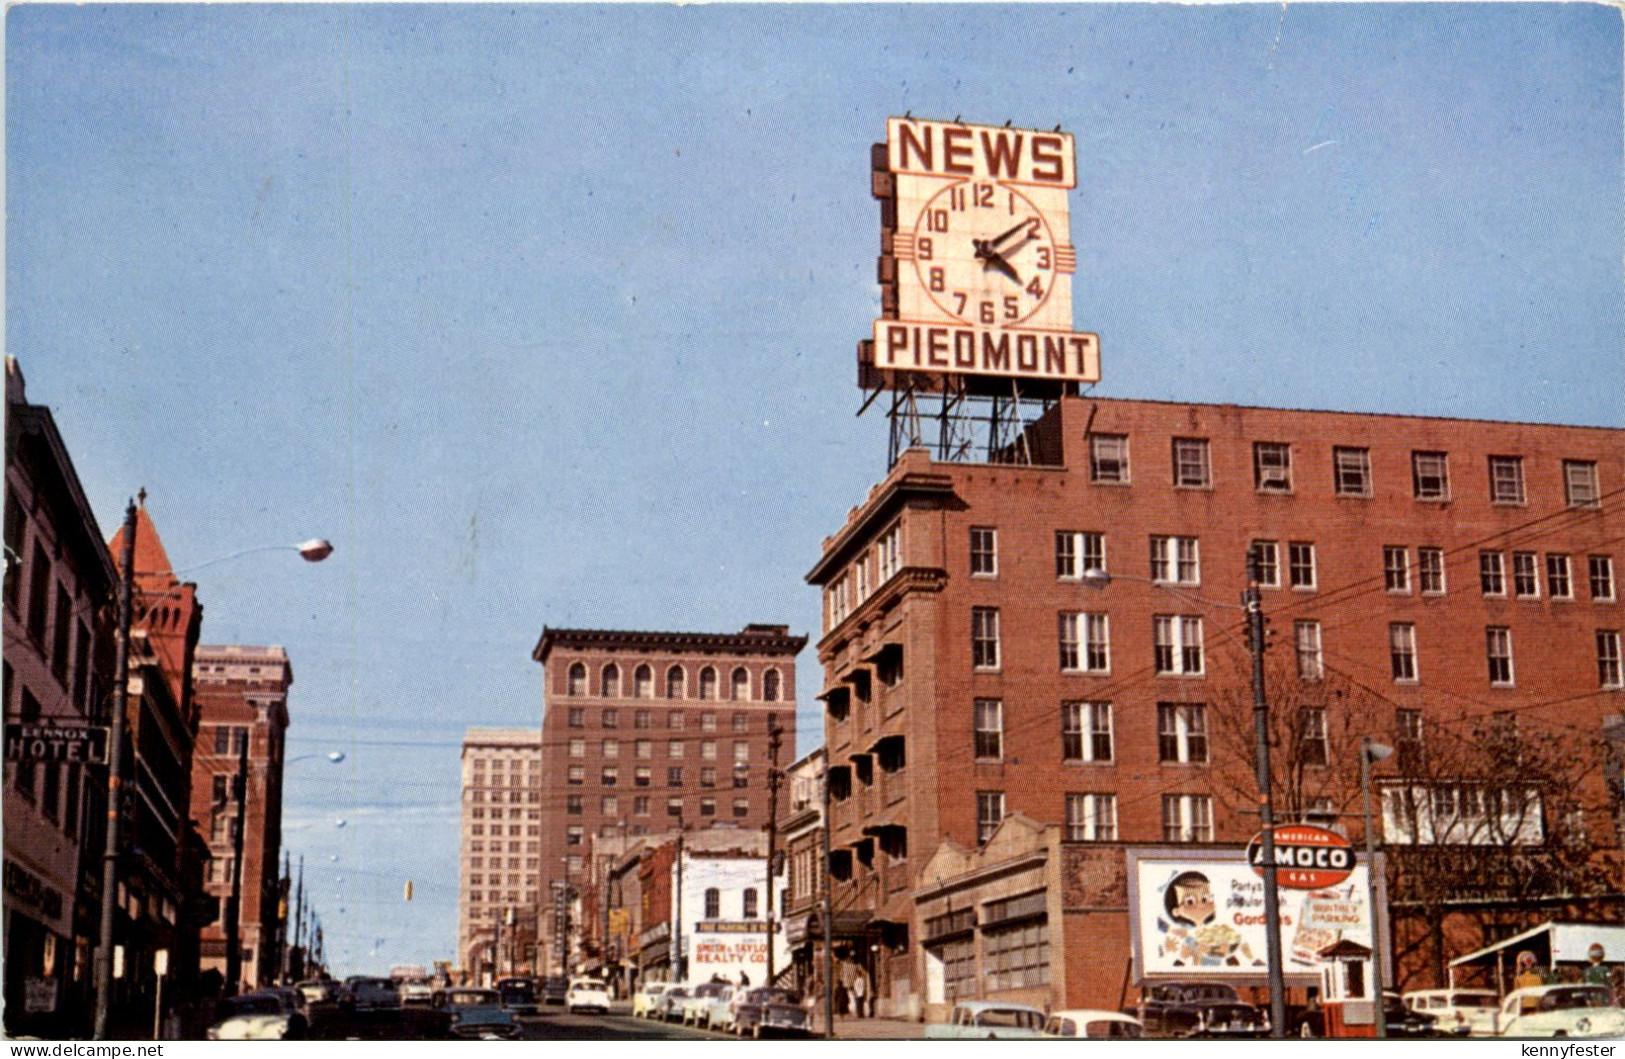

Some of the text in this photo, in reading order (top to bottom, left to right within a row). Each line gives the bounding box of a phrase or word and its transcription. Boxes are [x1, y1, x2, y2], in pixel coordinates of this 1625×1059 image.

[899, 123, 1064, 182] NEWS
[951, 187, 966, 211] 11
[973, 183, 994, 208] 12
[1009, 192, 1014, 216] 1
[927, 208, 948, 233] 10
[1026, 216, 1041, 239] 2
[918, 237, 933, 260] 9
[1036, 247, 1051, 270] 3
[929, 266, 945, 292] 8
[1026, 276, 1044, 300] 4
[953, 292, 967, 315] 7
[979, 301, 994, 324] 6
[1003, 297, 1019, 319] 5
[887, 325, 1090, 375] PIEDMONT
[22, 727, 88, 739] LENNOX
[9, 737, 102, 763] HOTEL
[1273, 832, 1329, 842] AMERICAN
[1289, 872, 1315, 881] GAS
[696, 954, 744, 963] REALTY
[735, 944, 768, 953] TAYLO
